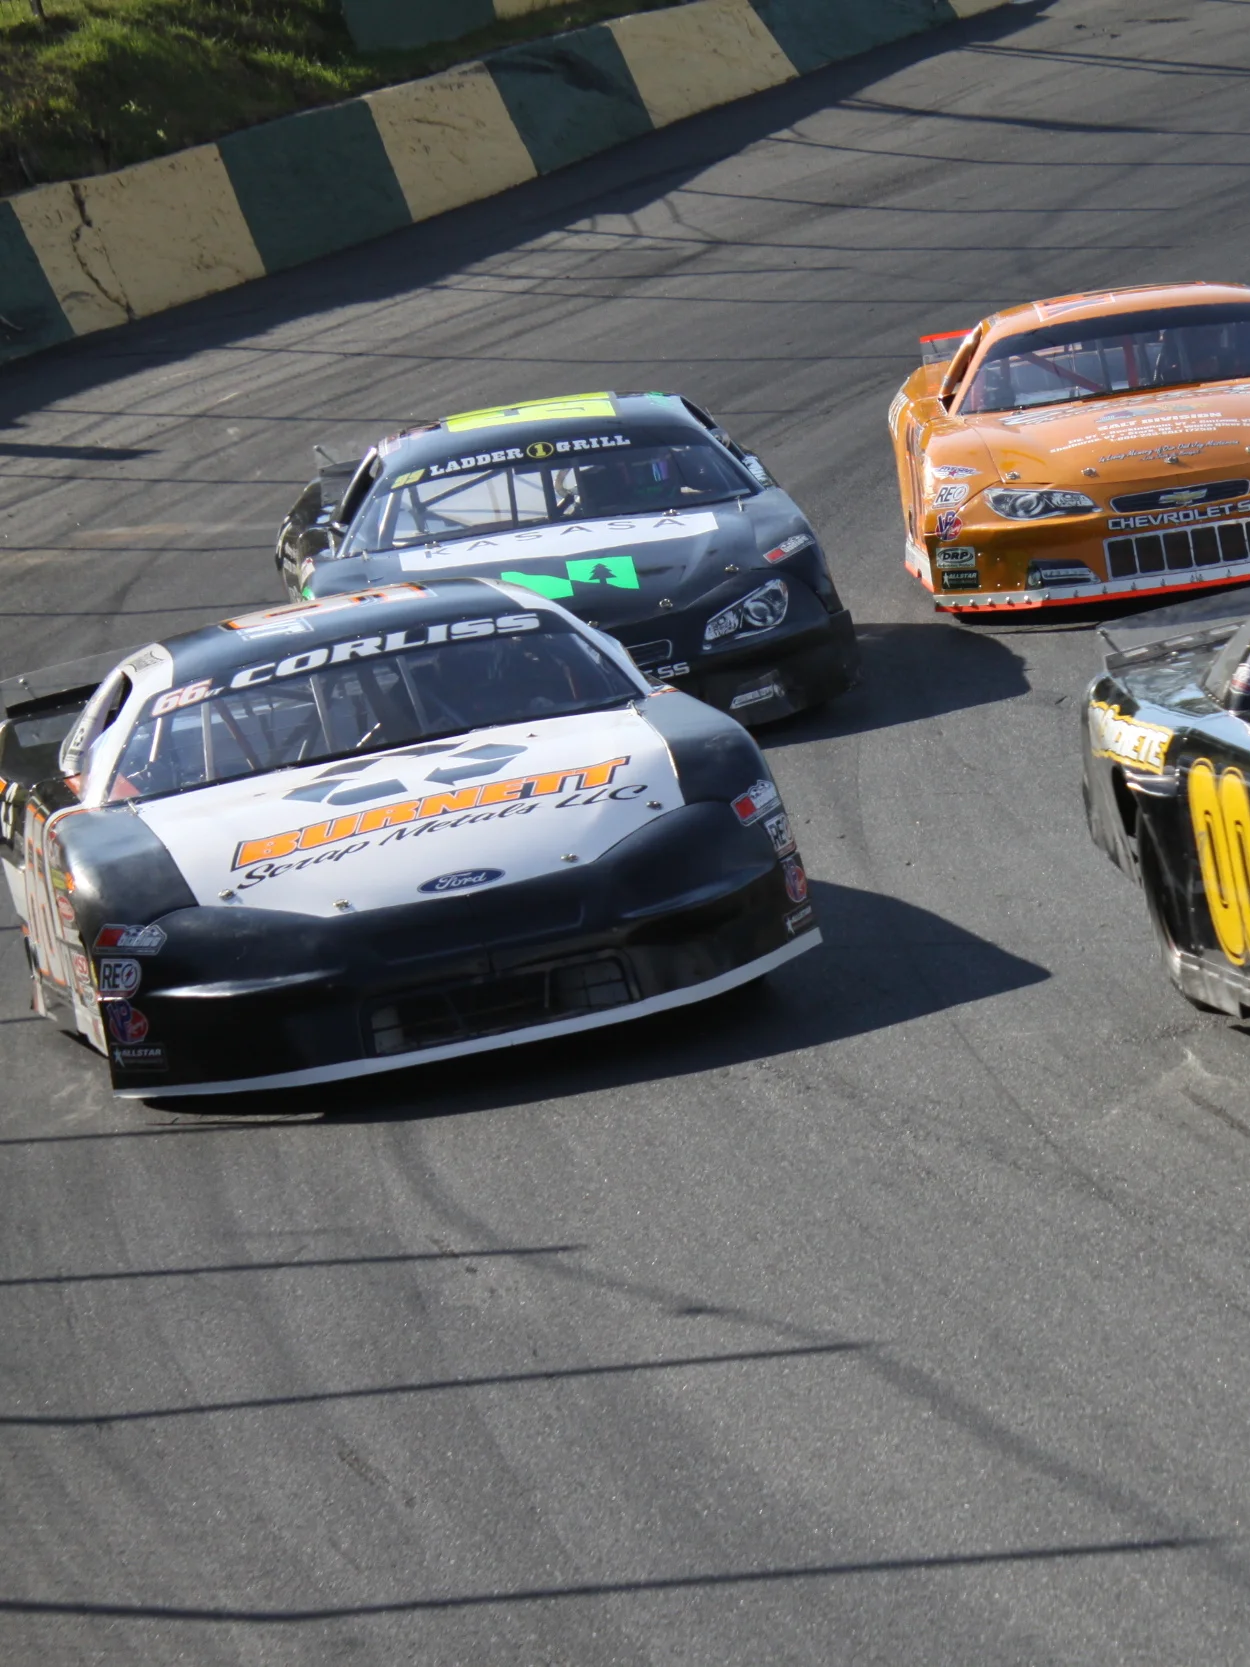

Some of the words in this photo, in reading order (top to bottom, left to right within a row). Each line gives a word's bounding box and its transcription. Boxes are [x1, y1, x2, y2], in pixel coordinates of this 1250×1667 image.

[1097, 420, 1137, 431] SALT
[1141, 412, 1222, 424] DIVISION
[430, 448, 524, 477] LADDER
[556, 435, 631, 453] GRILL
[1107, 503, 1234, 531] CHEVROLET
[424, 517, 686, 559] KASASA
[942, 551, 969, 562] DRP
[948, 572, 978, 580] ALLSTAR
[230, 613, 541, 689] CORLISS
[657, 662, 691, 679] SS
[151, 678, 213, 717] 66
[231, 755, 632, 873] BURNETT
[237, 839, 371, 890] Scrap
[379, 802, 543, 847] Metals
[554, 784, 649, 811] LLC
[434, 871, 488, 891] Ford
[120, 1048, 162, 1058] ALLSTAR
